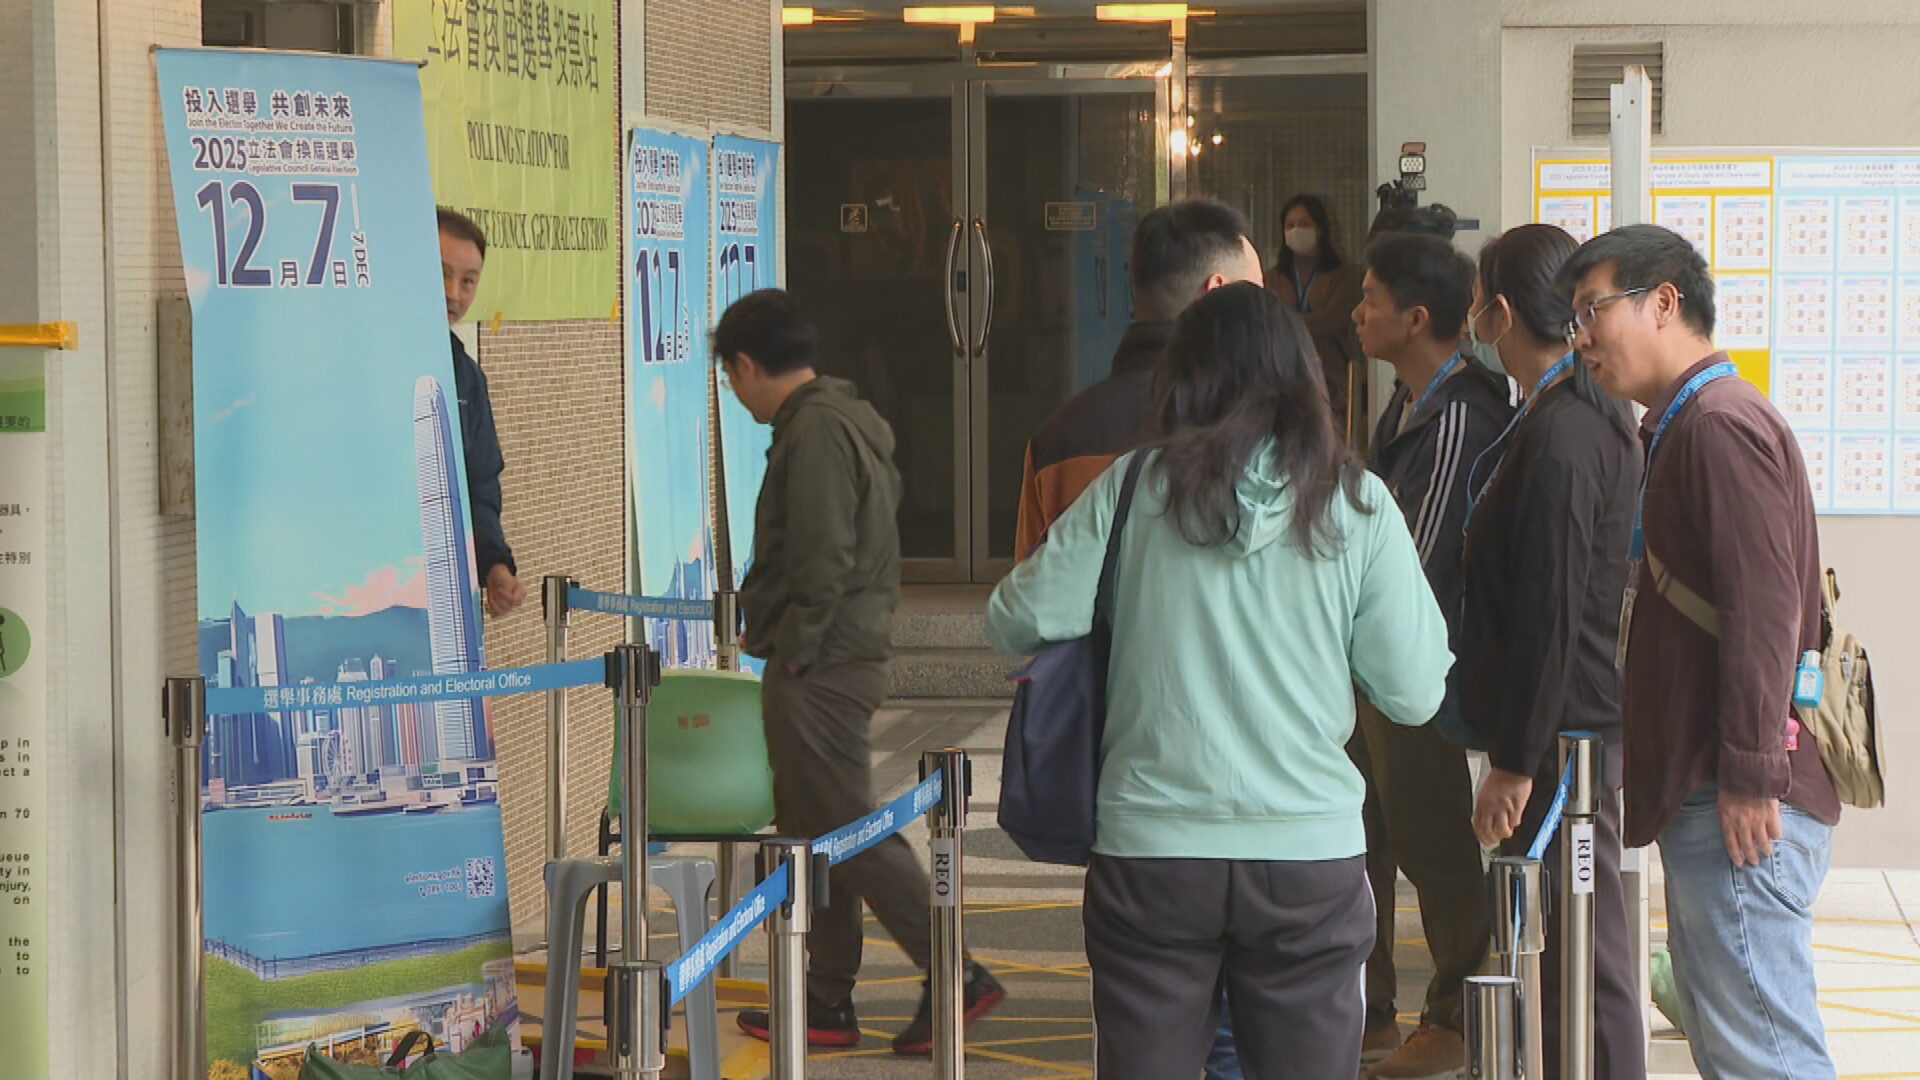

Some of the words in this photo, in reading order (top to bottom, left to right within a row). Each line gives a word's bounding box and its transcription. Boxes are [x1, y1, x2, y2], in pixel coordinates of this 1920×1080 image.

[185, 89, 257, 116] 投入選舉
[272, 92, 351, 119] 共創未來
[189, 118, 204, 127] Join
[205, 118, 217, 127] the
[219, 118, 243, 128] Election
[275, 121, 288, 131] We
[290, 121, 315, 131] Create
[316, 121, 327, 131] the
[328, 122, 353, 133] Future
[283, 163, 309, 173] Council
[352, 233, 364, 244] 7
[354, 249, 370, 286] DEC
[346, 682, 418, 702] Registration
[420, 680, 443, 695] and
[445, 674, 496, 693] Electoral
[498, 672, 532, 689] Office
[17, 737, 30, 749] in
[17, 751, 30, 763] in
[23, 767, 30, 777] a
[15, 807, 30, 819] 70
[1577, 839, 1591, 882] REO
[17, 866, 30, 876] in
[935, 853, 950, 897] REO
[13, 896, 30, 905] on
[8, 936, 30, 947] the
[16, 951, 30, 961] to
[16, 965, 30, 975] to
